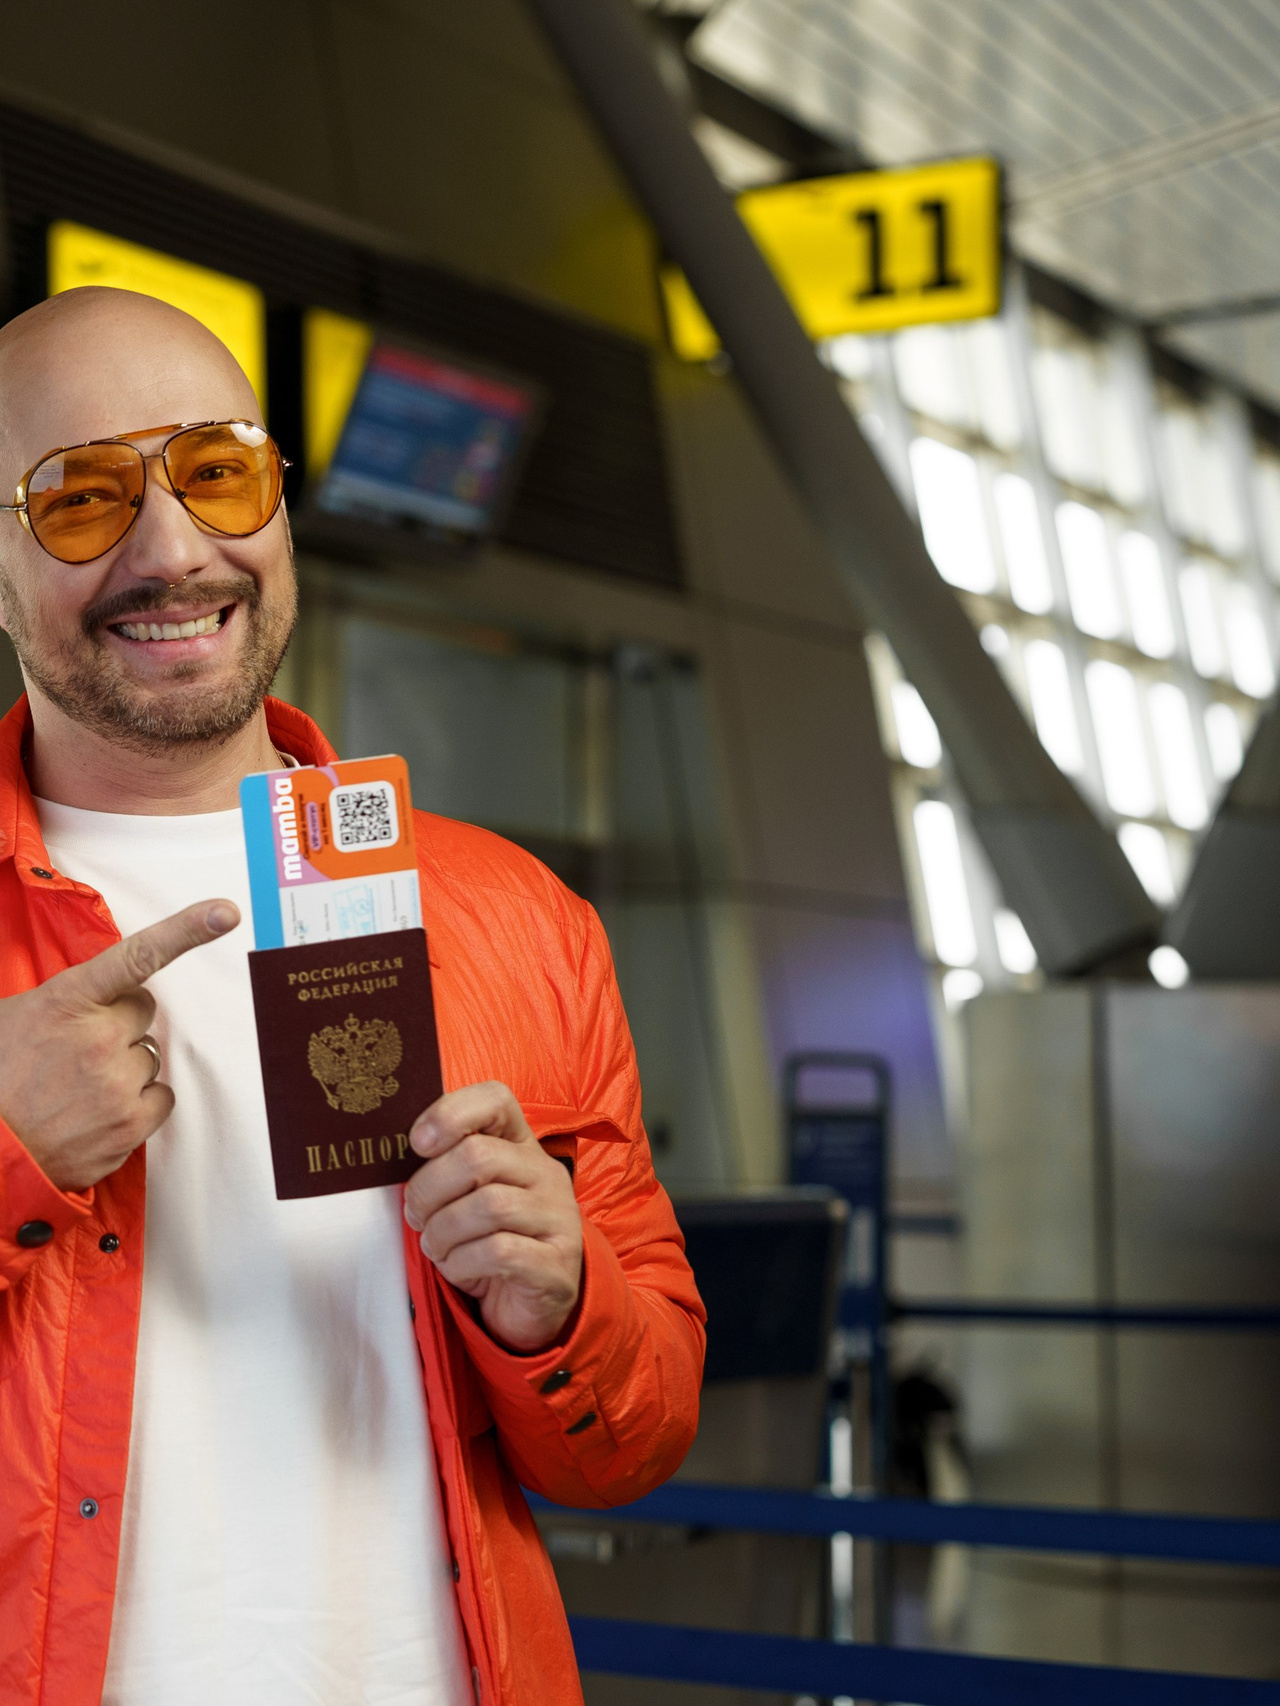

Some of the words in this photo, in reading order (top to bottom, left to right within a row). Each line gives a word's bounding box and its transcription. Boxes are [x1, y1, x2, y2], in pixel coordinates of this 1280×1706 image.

[855, 201, 962, 300] 11
[273, 778, 302, 880] mamba
[287, 957, 404, 985] РОССИЙСКАЯ
[298, 975, 399, 1002] ФЕДЕРАЦИЯ
